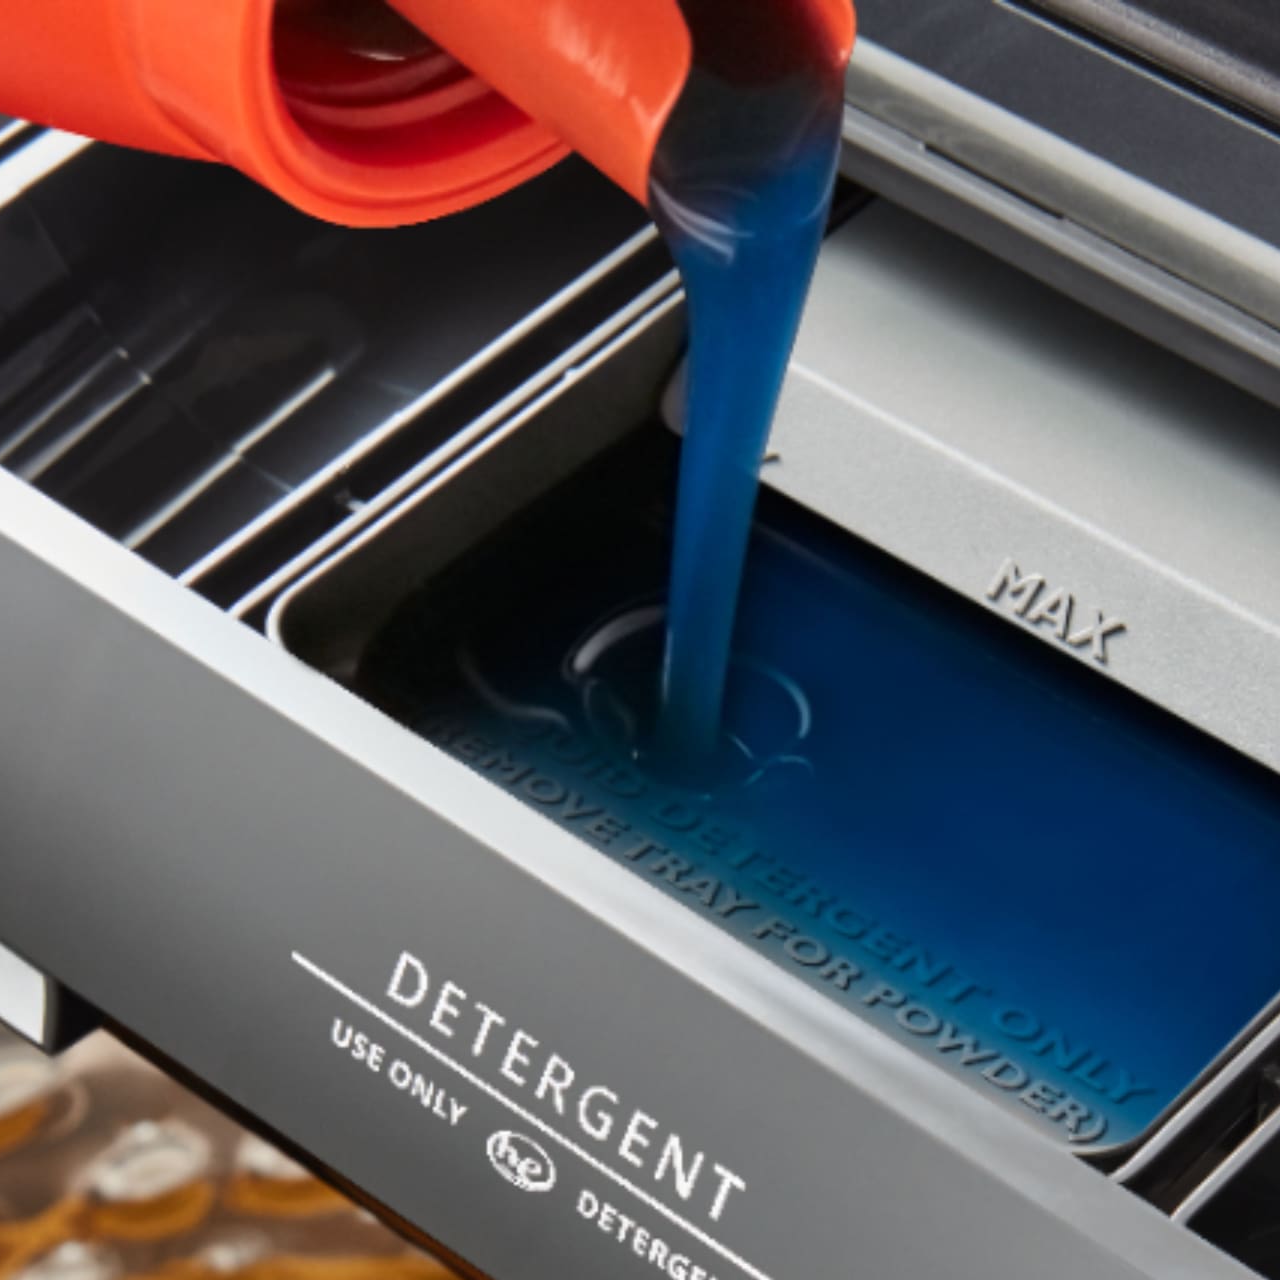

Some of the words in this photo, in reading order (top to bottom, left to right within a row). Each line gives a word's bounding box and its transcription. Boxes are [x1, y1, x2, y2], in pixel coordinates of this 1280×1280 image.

[985, 557, 1127, 665] MAX
[332, 1019, 384, 1072] USE
[388, 1059, 468, 1126] ONLY
[625, 842, 760, 920] TRAY
[753, 913, 865, 991] FOR
[861, 987, 1108, 1145] POWDER)
[648, 794, 995, 1004] DETERGENT
[991, 1005, 1157, 1104] ONLY
[386, 951, 746, 1221] DETERGENT
